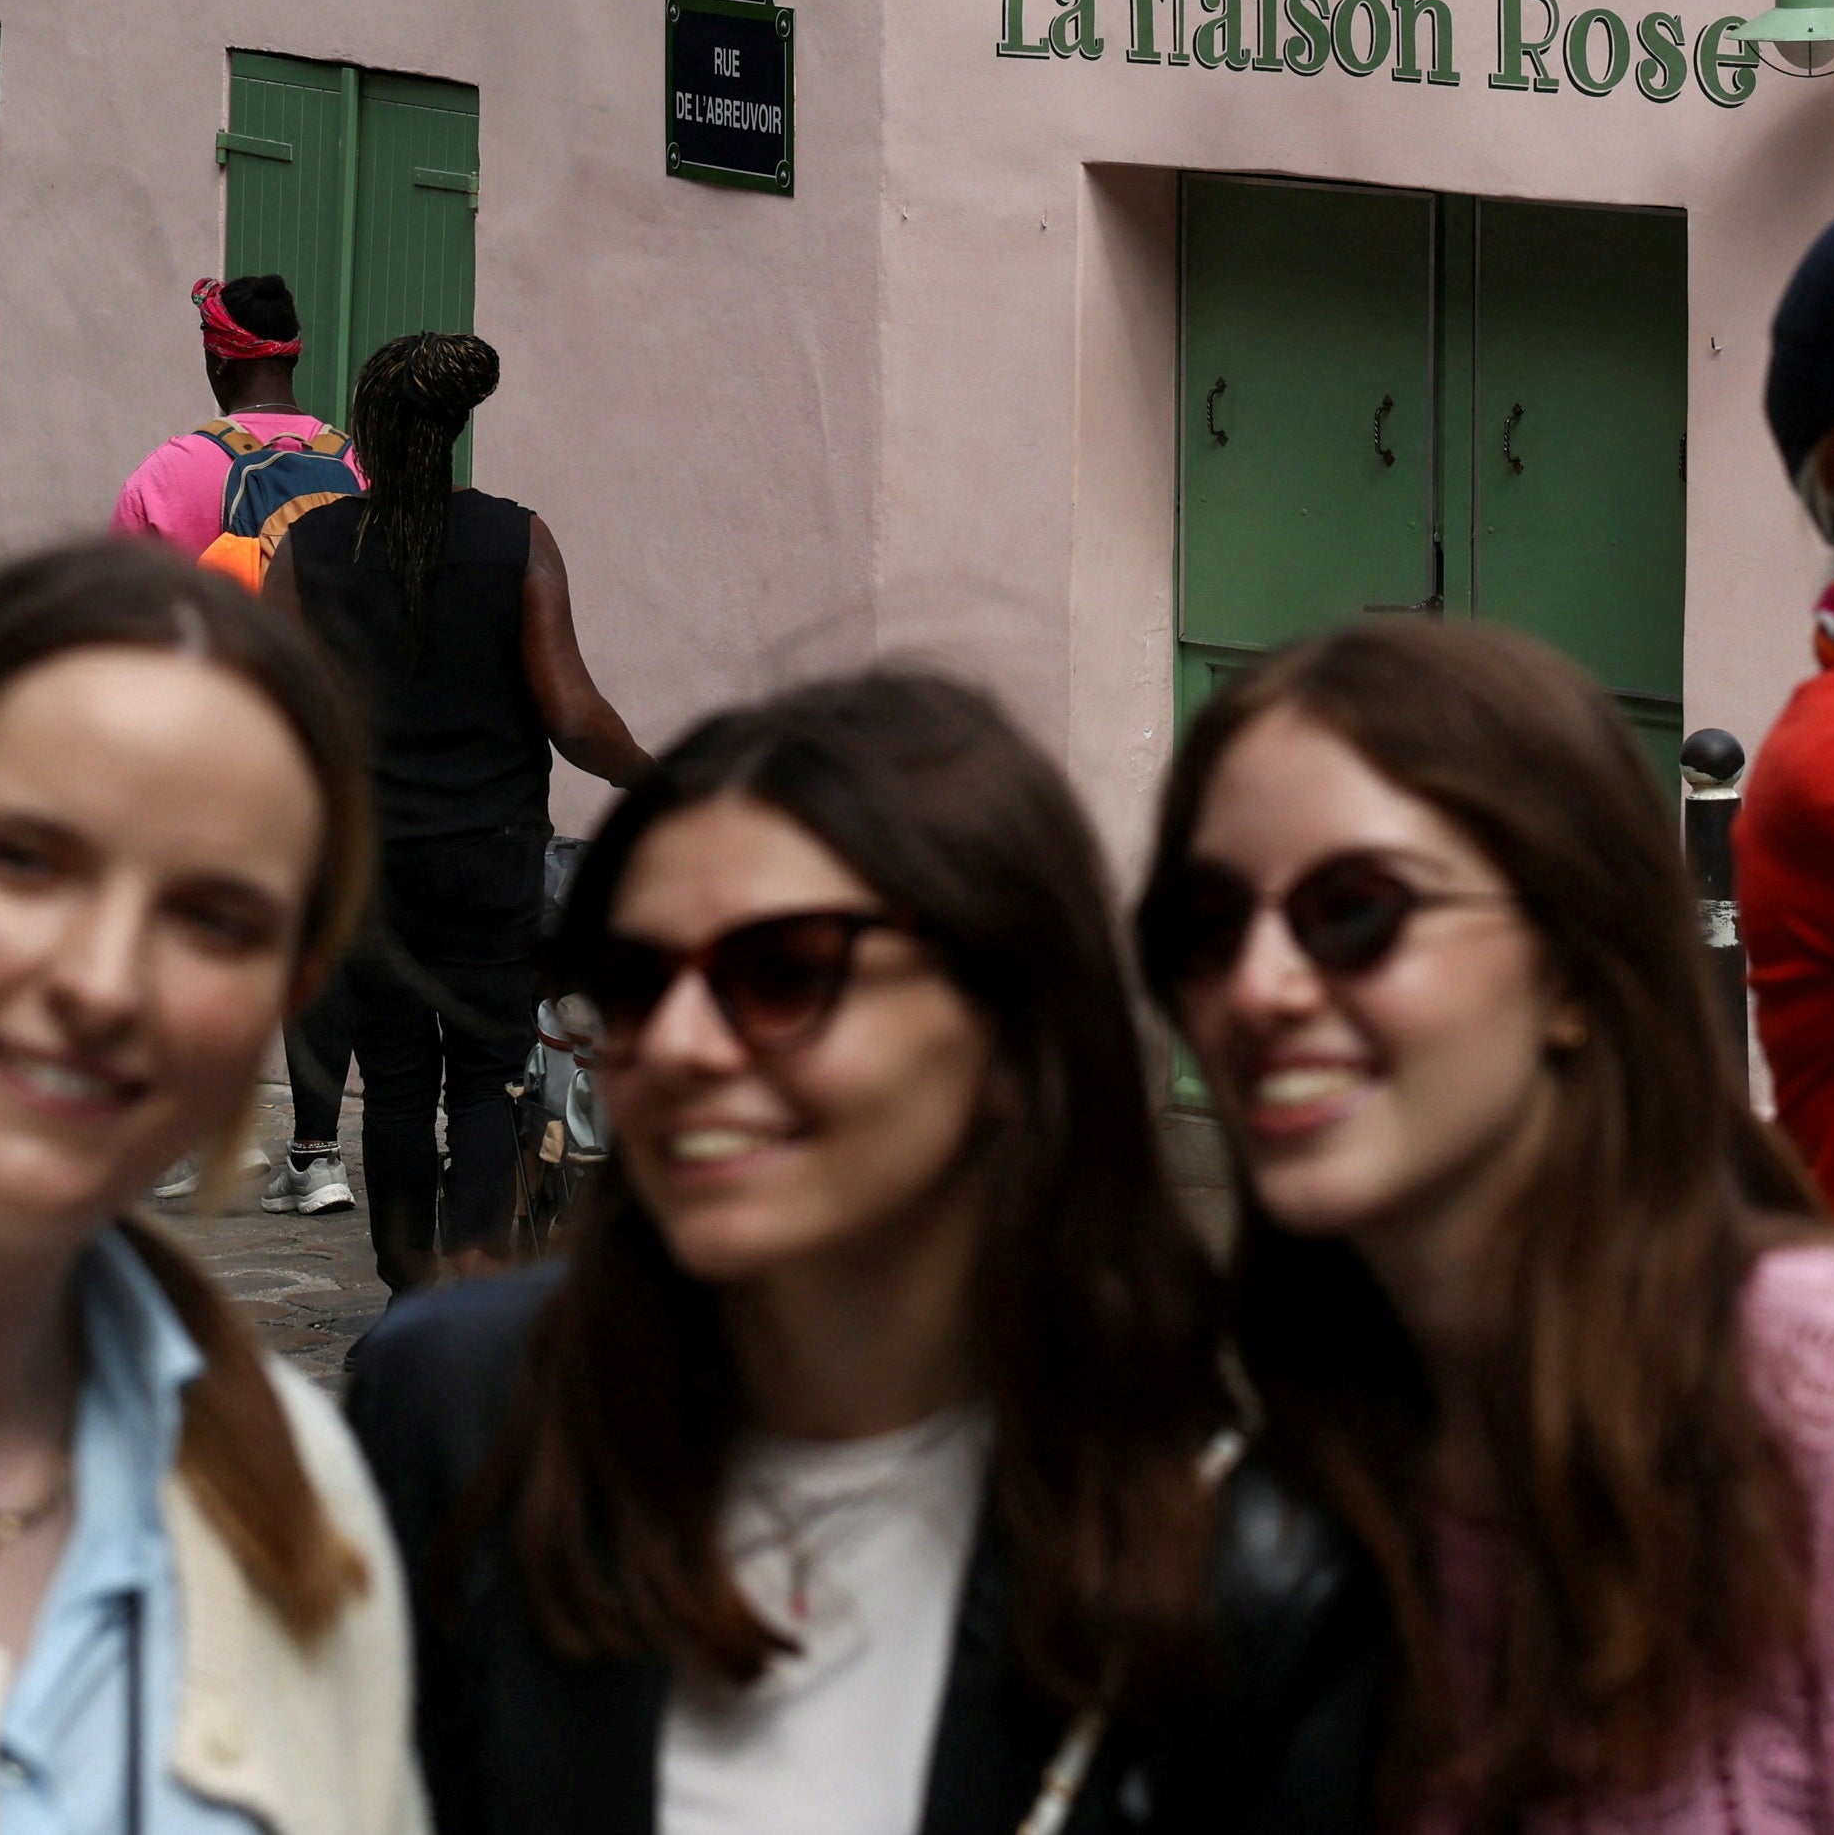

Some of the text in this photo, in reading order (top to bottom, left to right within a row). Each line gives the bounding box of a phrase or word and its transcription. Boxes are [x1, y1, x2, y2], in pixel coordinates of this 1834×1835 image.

[714, 47, 740, 78] RUE
[676, 91, 782, 135] DE L'ABREUVOIR
